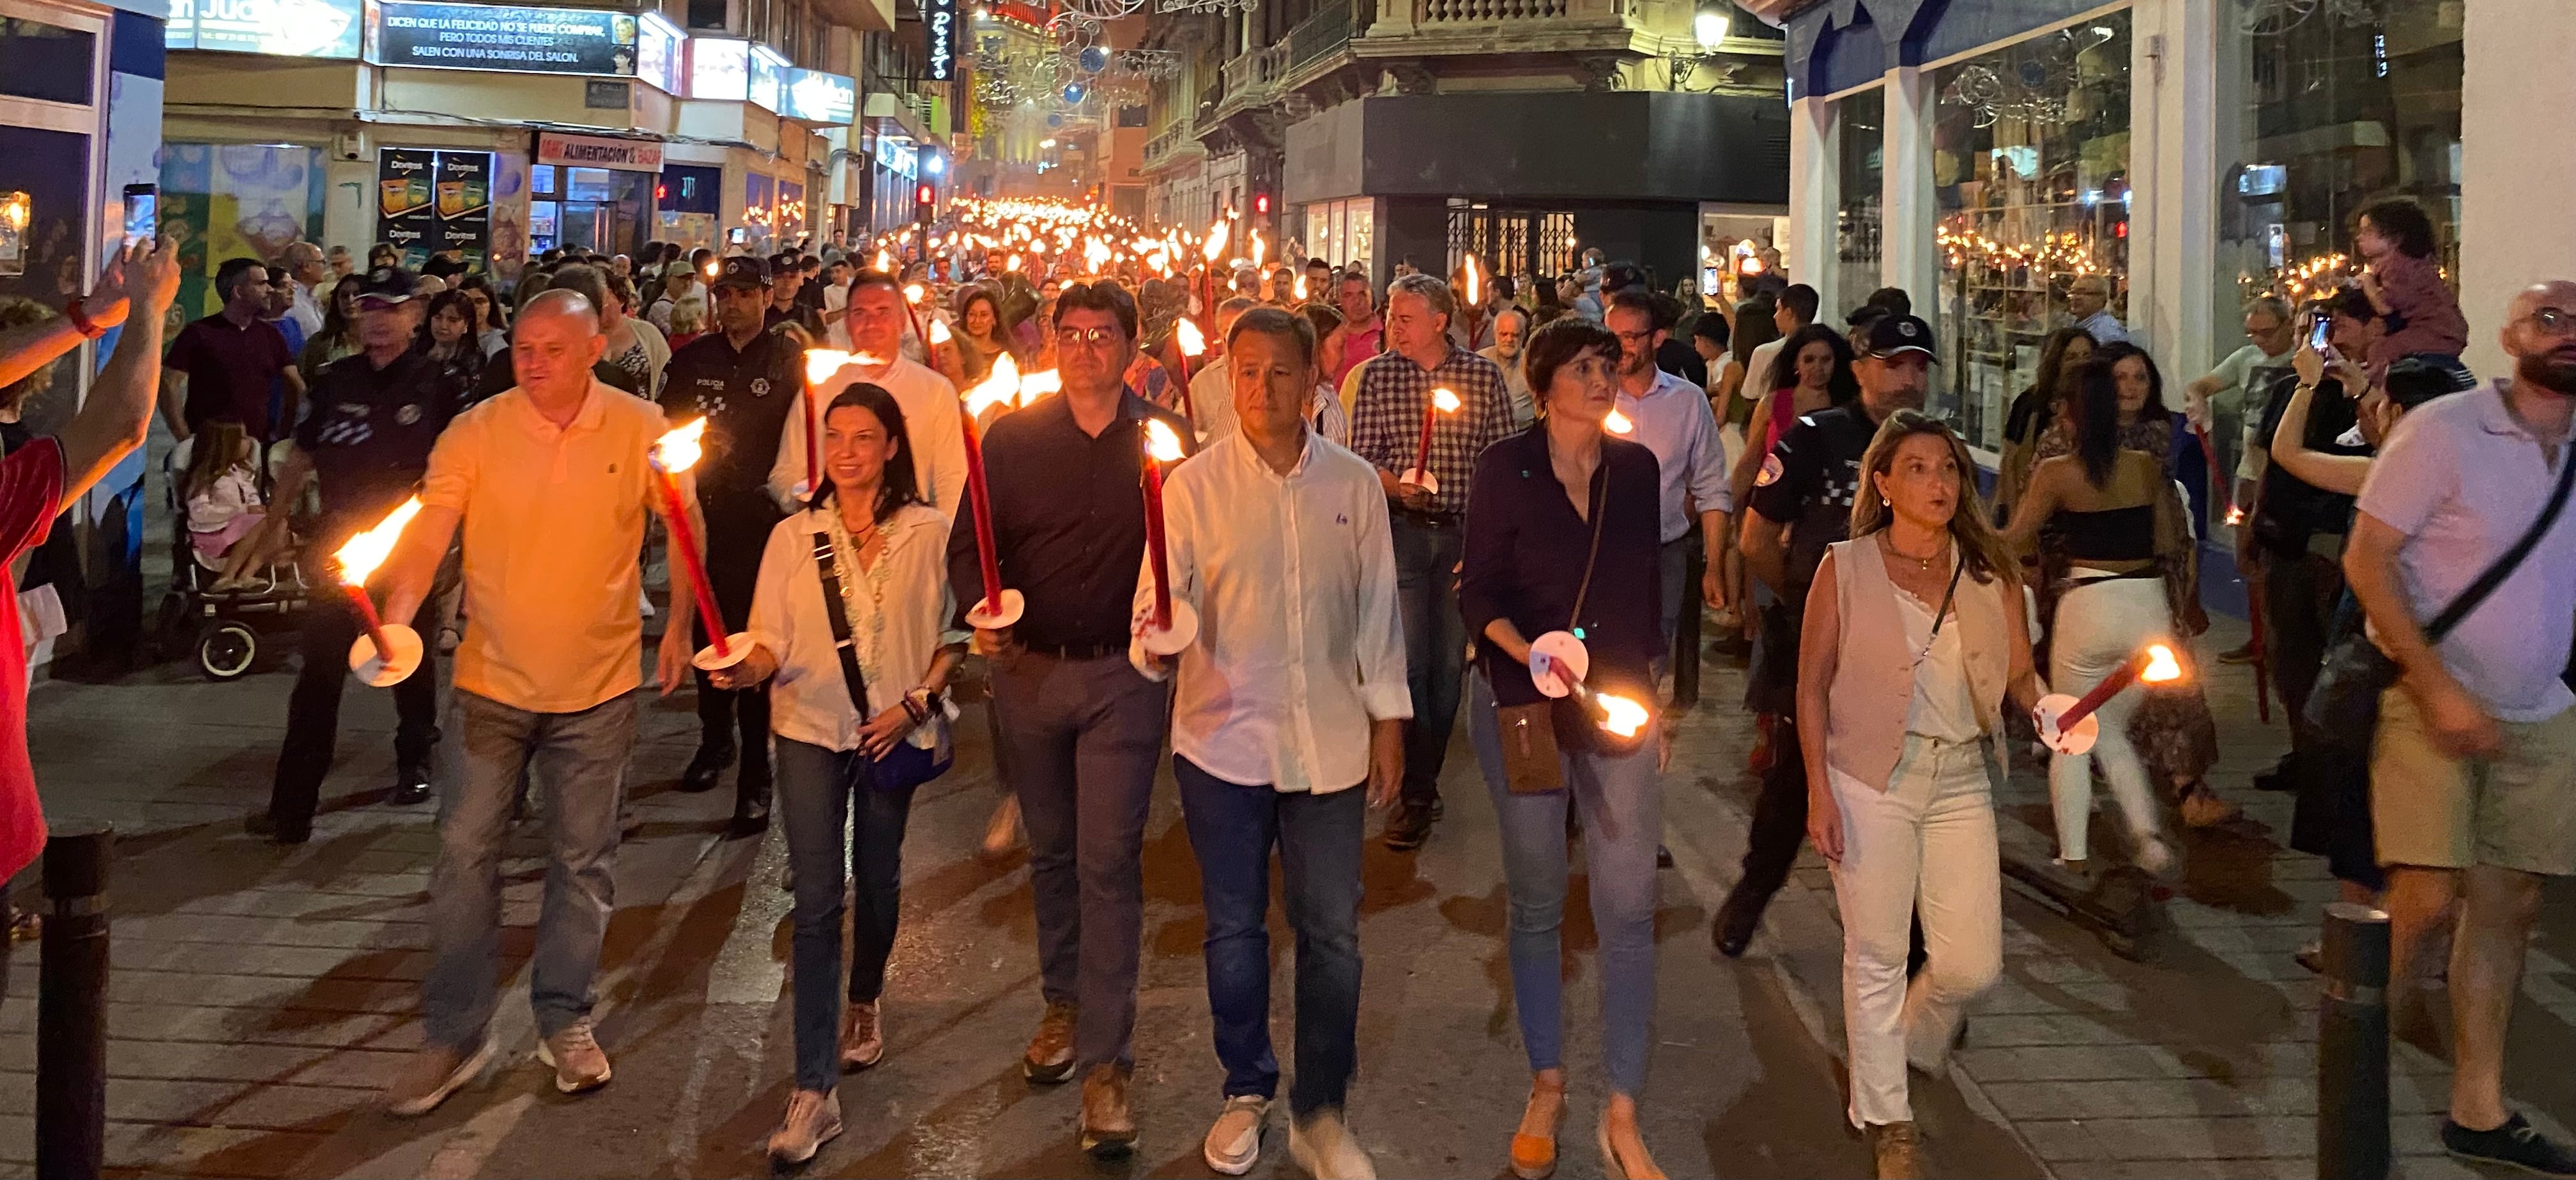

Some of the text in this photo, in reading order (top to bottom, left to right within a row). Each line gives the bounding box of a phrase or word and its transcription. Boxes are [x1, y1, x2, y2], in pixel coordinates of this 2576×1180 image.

[388, 17, 417, 28] DICEN
[418, 18, 438, 29] QUE
[439, 19, 450, 29] LA
[452, 20, 498, 31] FELICIDAD
[500, 22, 516, 32] NO
[516, 22, 527, 32] SE
[528, 22, 556, 34] PUEDE
[440, 32, 555, 47] PERO TODOS MIS CLIENTES
[413, 45, 441, 56] SALEN
[441, 47, 465, 57] CON
[466, 49, 486, 59] UNA
[487, 50, 527, 61] SONRISA
[528, 51, 546, 61] DEL
[563, 143, 628, 163] ALIMENTACIÓN
[628, 146, 635, 164] &
